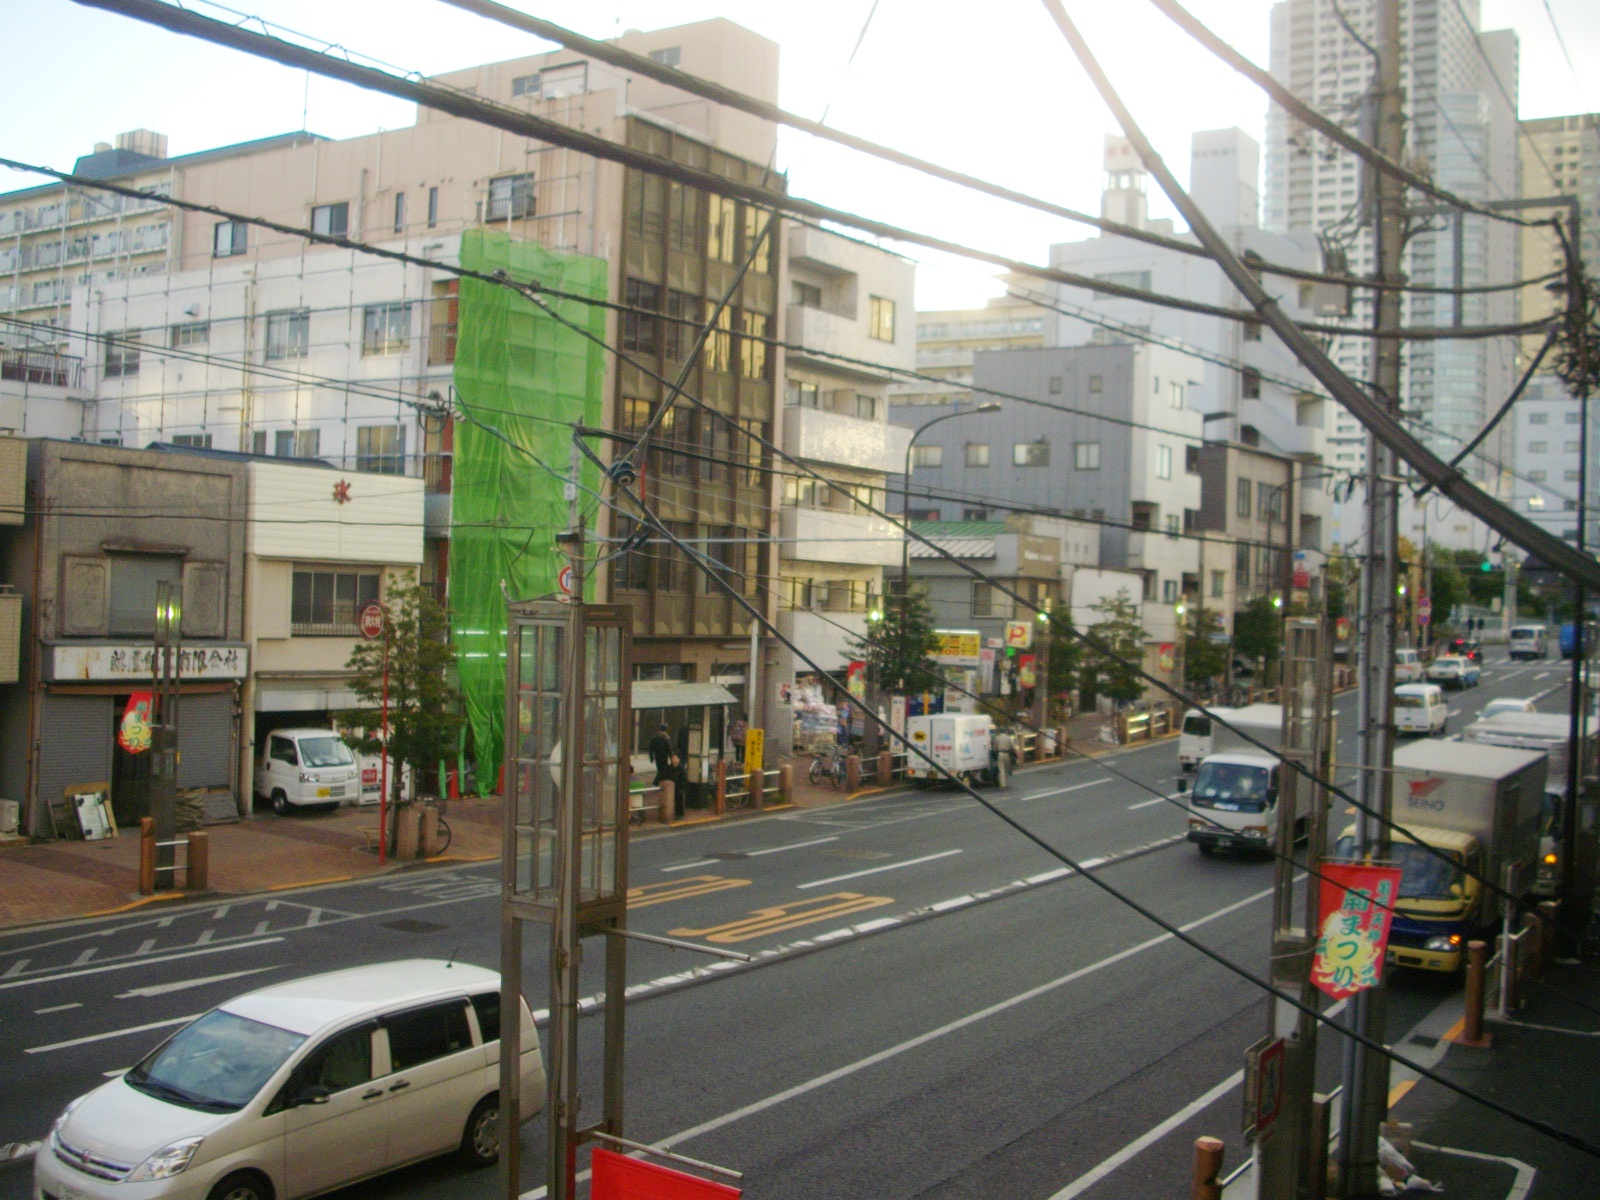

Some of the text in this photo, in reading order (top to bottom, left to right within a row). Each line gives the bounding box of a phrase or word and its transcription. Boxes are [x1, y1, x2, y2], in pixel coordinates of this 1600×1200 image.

[1008, 626, 1025, 644] P
[110, 649, 239, 673] 有限会社
